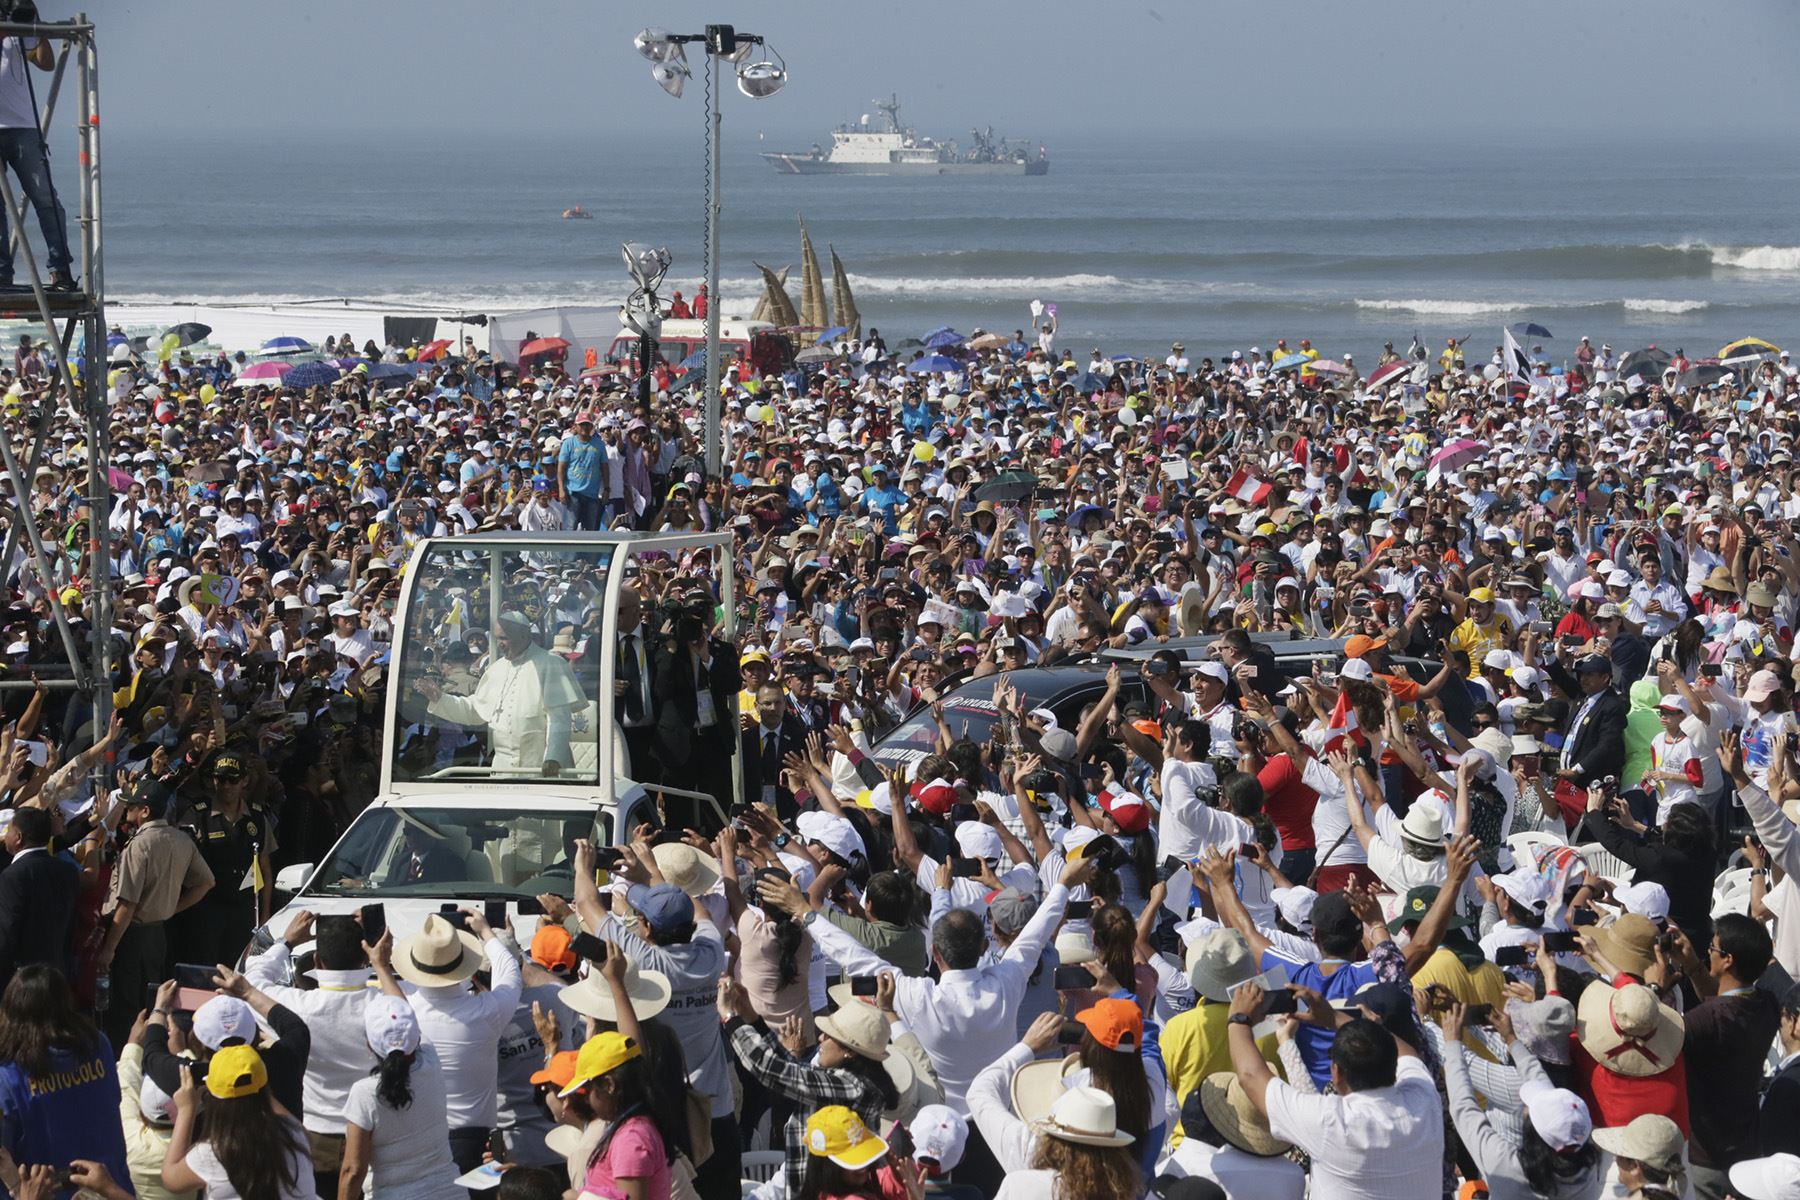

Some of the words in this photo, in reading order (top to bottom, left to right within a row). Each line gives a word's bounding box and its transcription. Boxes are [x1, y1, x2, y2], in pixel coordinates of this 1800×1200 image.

[666, 999, 683, 1009] an
[499, 1043, 527, 1060] San
[28, 1058, 105, 1097] PROTOCOLO
